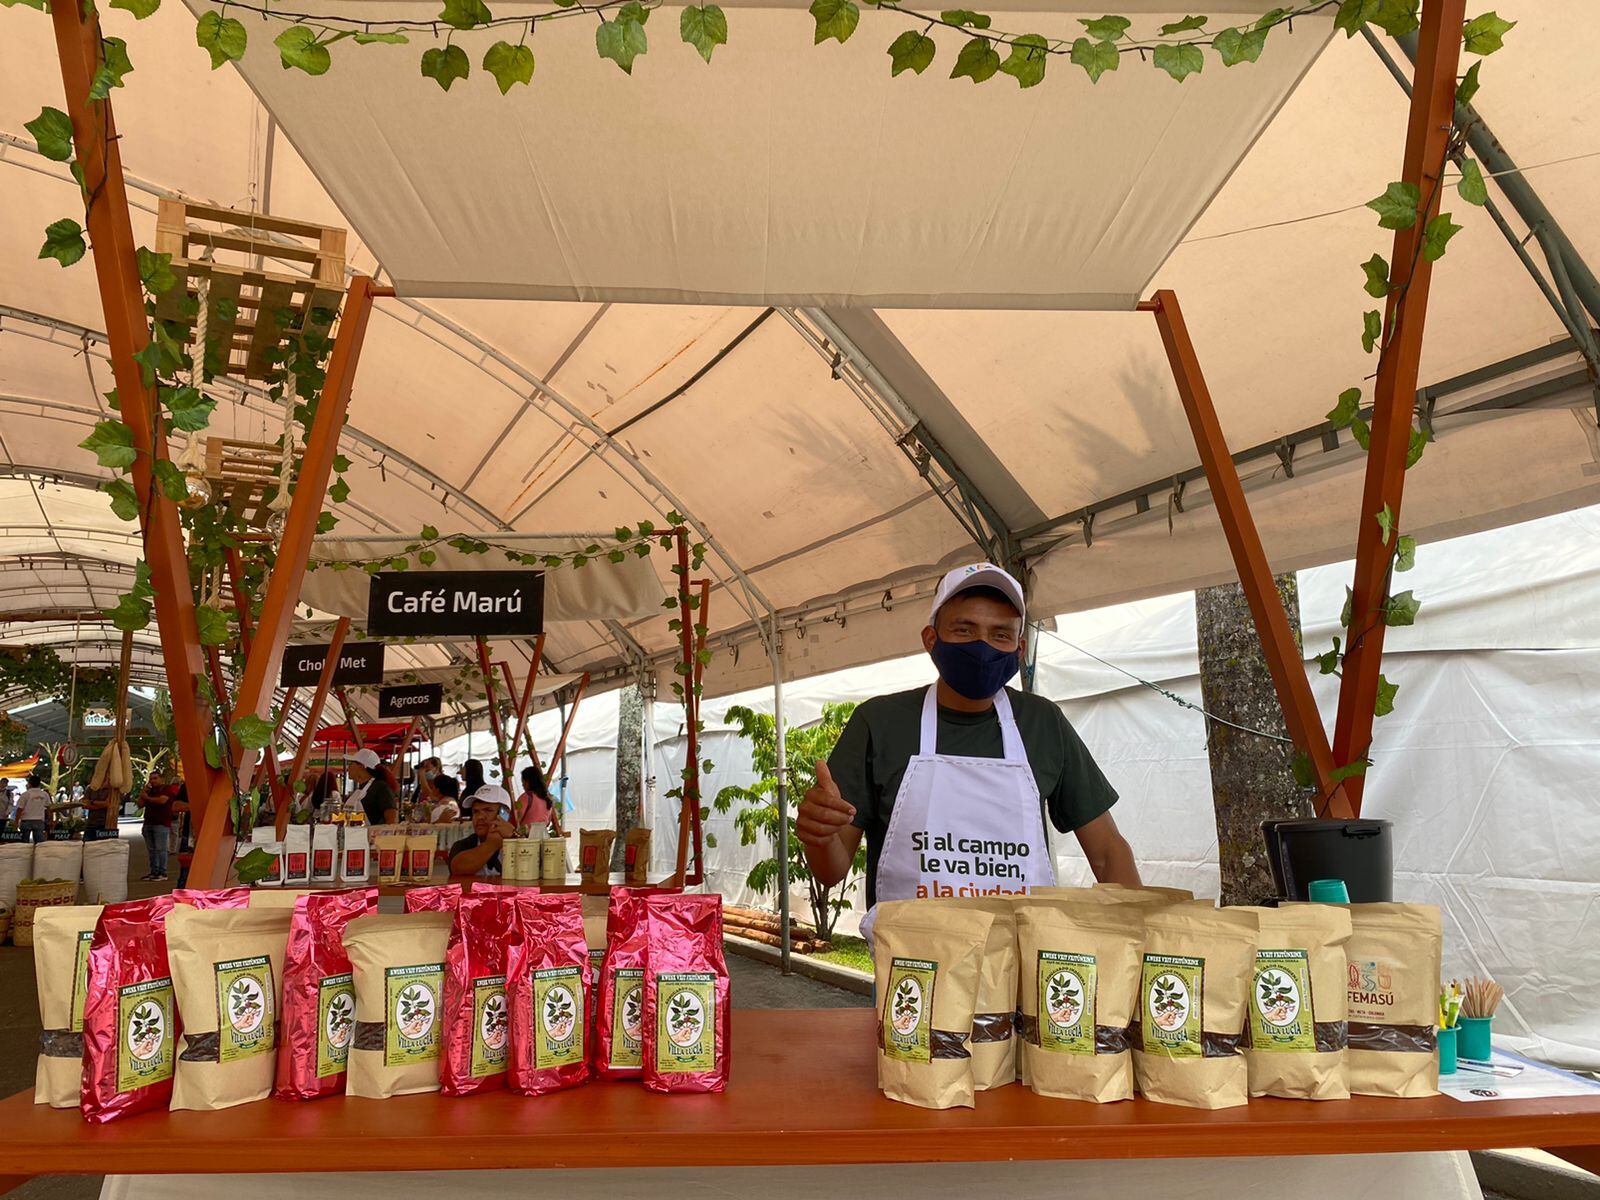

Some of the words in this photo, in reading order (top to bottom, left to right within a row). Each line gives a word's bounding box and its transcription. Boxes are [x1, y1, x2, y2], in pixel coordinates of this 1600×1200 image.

[388, 588, 446, 613] Café
[453, 588, 522, 613] Marú
[340, 656, 367, 669] Met
[390, 694, 430, 708] Agrocos
[911, 830, 929, 851] Si
[934, 832, 955, 852] al
[958, 838, 1030, 860] campo
[920, 854, 941, 873] le
[944, 858, 970, 875] va
[974, 856, 1026, 882] bien,
[916, 884, 928, 899] a
[933, 880, 954, 898] la
